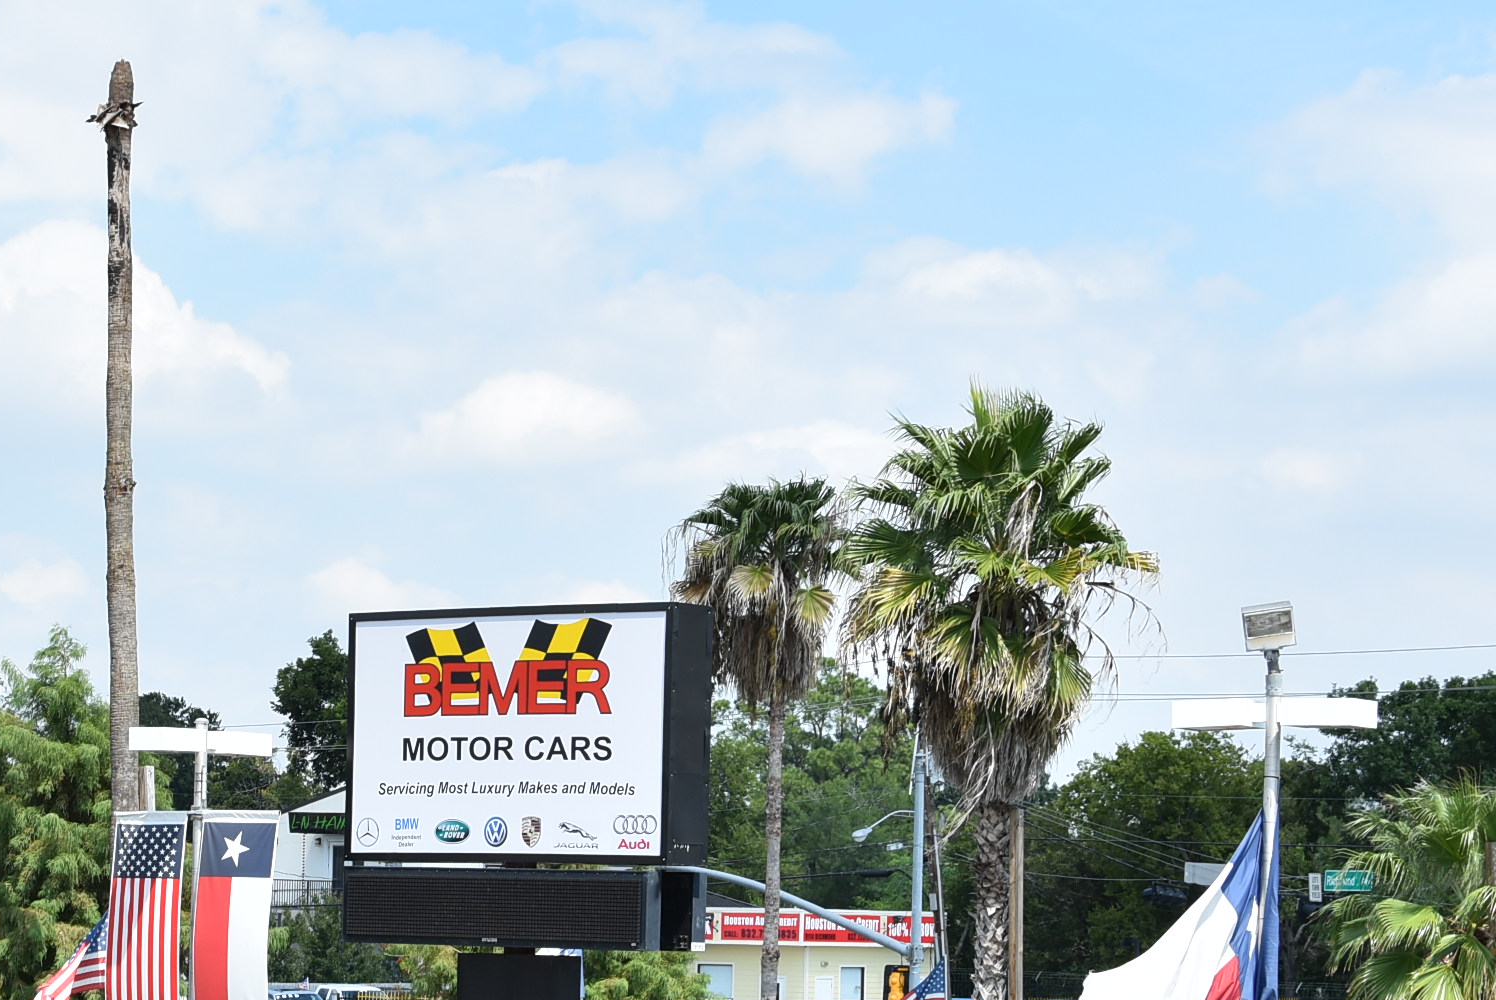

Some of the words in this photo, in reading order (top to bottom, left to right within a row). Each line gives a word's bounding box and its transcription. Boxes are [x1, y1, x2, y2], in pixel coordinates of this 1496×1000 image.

[404, 659, 612, 717] BEMER
[403, 736, 514, 762] MOTOR
[524, 735, 613, 762] CARS
[378, 782, 435, 798] Servicing
[438, 781, 469, 795] Most
[471, 781, 515, 798] Luxury
[518, 781, 558, 795] Makes
[561, 781, 587, 795] and
[589, 781, 636, 796] Models
[395, 817, 420, 831] BMW
[391, 834, 422, 842] Independent
[617, 838, 650, 850] Audi
[724, 915, 754, 926] HOUSTON
[755, 915, 765, 926] AU
[779, 917, 798, 927] REDIT
[805, 915, 837, 931] HOUSTON
